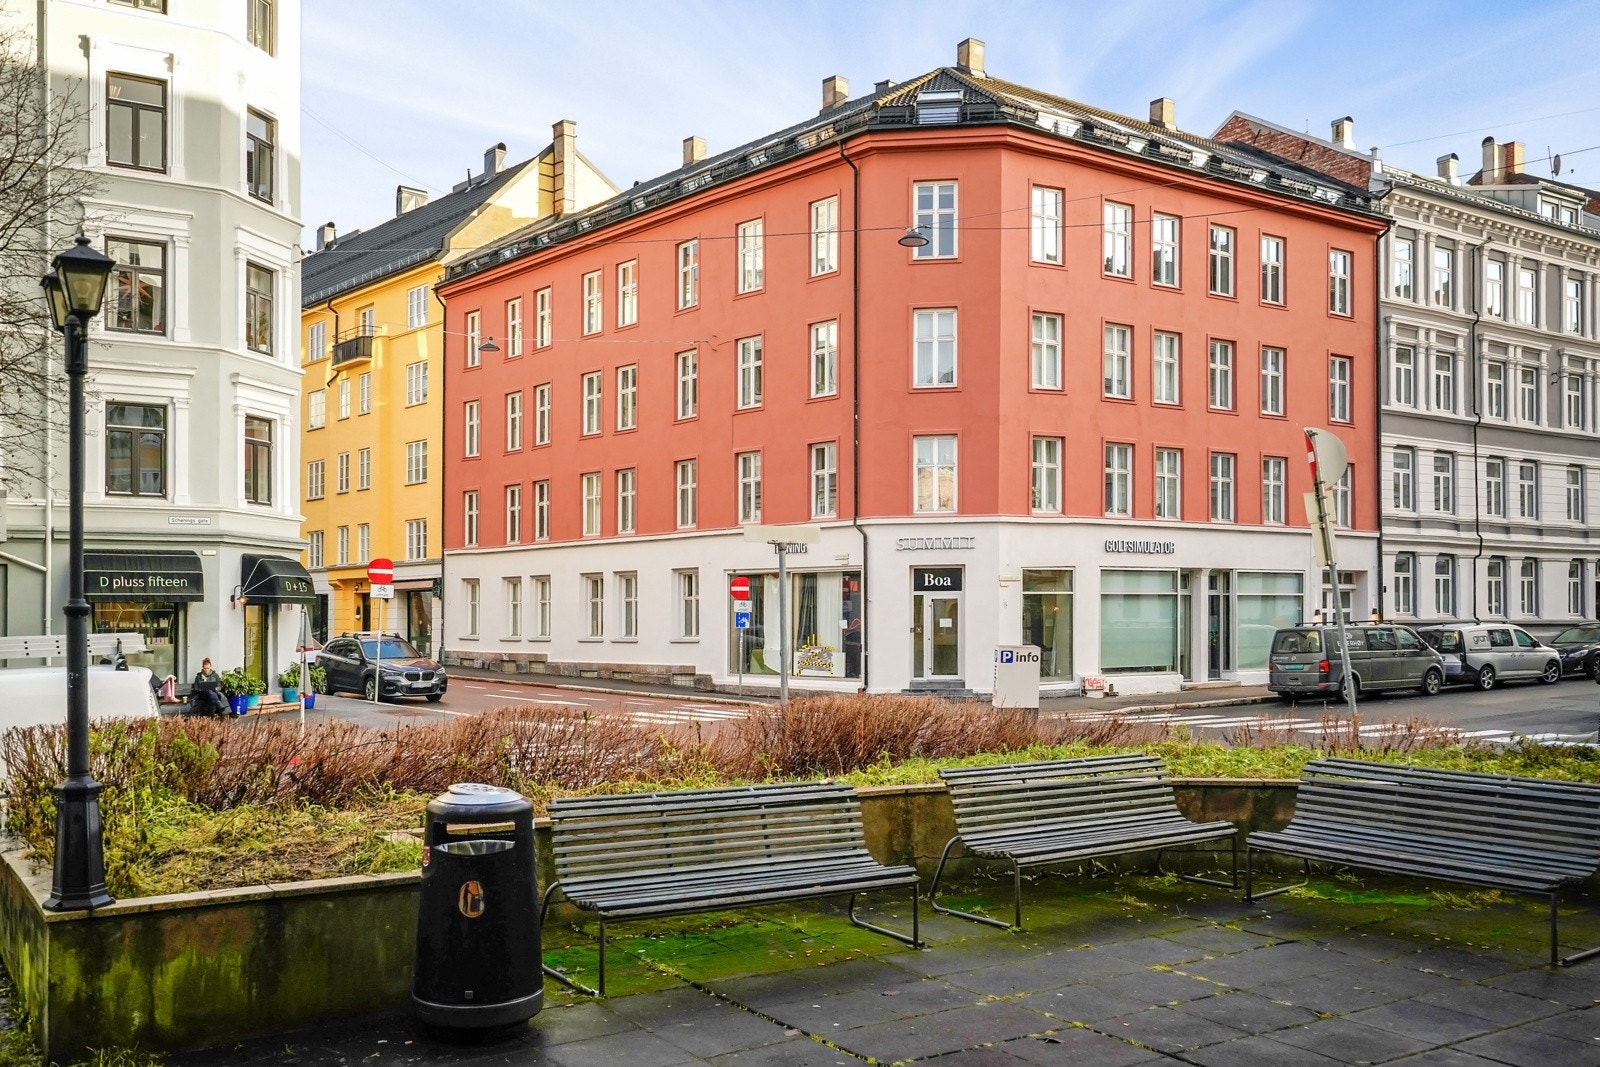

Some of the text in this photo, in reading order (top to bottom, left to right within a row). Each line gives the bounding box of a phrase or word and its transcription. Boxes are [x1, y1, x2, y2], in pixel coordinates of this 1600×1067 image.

[896, 537, 975, 551] SUMMIT
[1104, 540, 1175, 554] GOLFSIMULATOR
[99, 575, 189, 590] D pluss fifteen
[924, 573, 952, 587] Boa
[1002, 651, 1040, 663] P info
